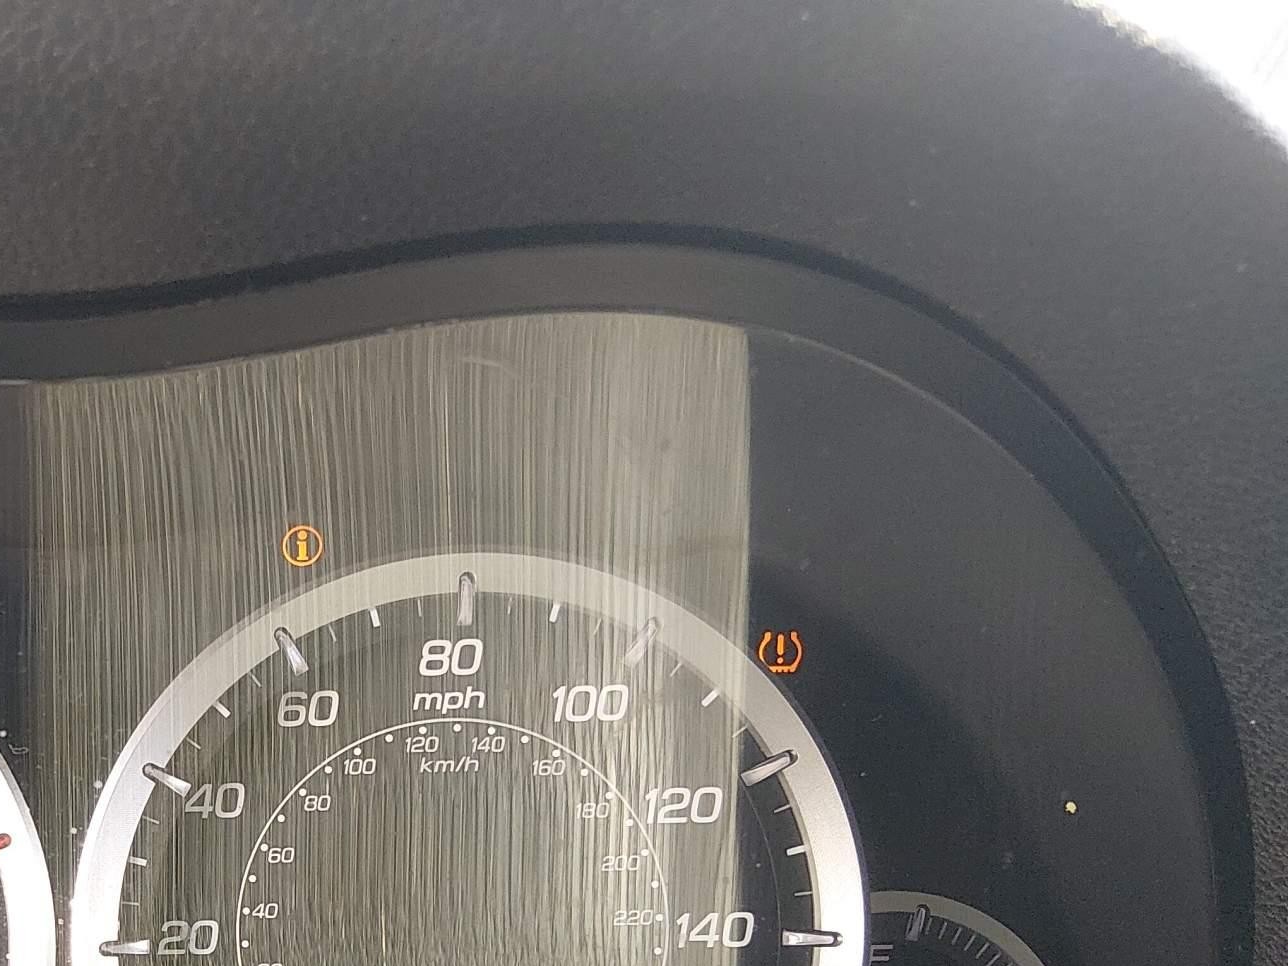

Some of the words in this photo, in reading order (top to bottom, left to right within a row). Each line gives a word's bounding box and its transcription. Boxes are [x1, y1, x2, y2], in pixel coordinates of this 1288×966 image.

[418, 638, 484, 676] 80
[277, 690, 339, 727] 60
[412, 686, 486, 714] mph
[552, 684, 629, 723] 100
[405, 736, 439, 753] 120
[471, 737, 505, 753] 140
[343, 759, 376, 775] 100
[419, 756, 480, 774] km/h
[532, 760, 565, 776] 160
[184, 783, 245, 819] 40
[304, 795, 330, 811] 80
[644, 786, 723, 824] 120
[575, 802, 609, 819] 180
[268, 847, 295, 863] 60
[602, 855, 640, 871] 200
[252, 903, 279, 918] 40
[614, 910, 653, 926] 220
[158, 920, 219, 955] 20
[675, 912, 754, 949] 140
